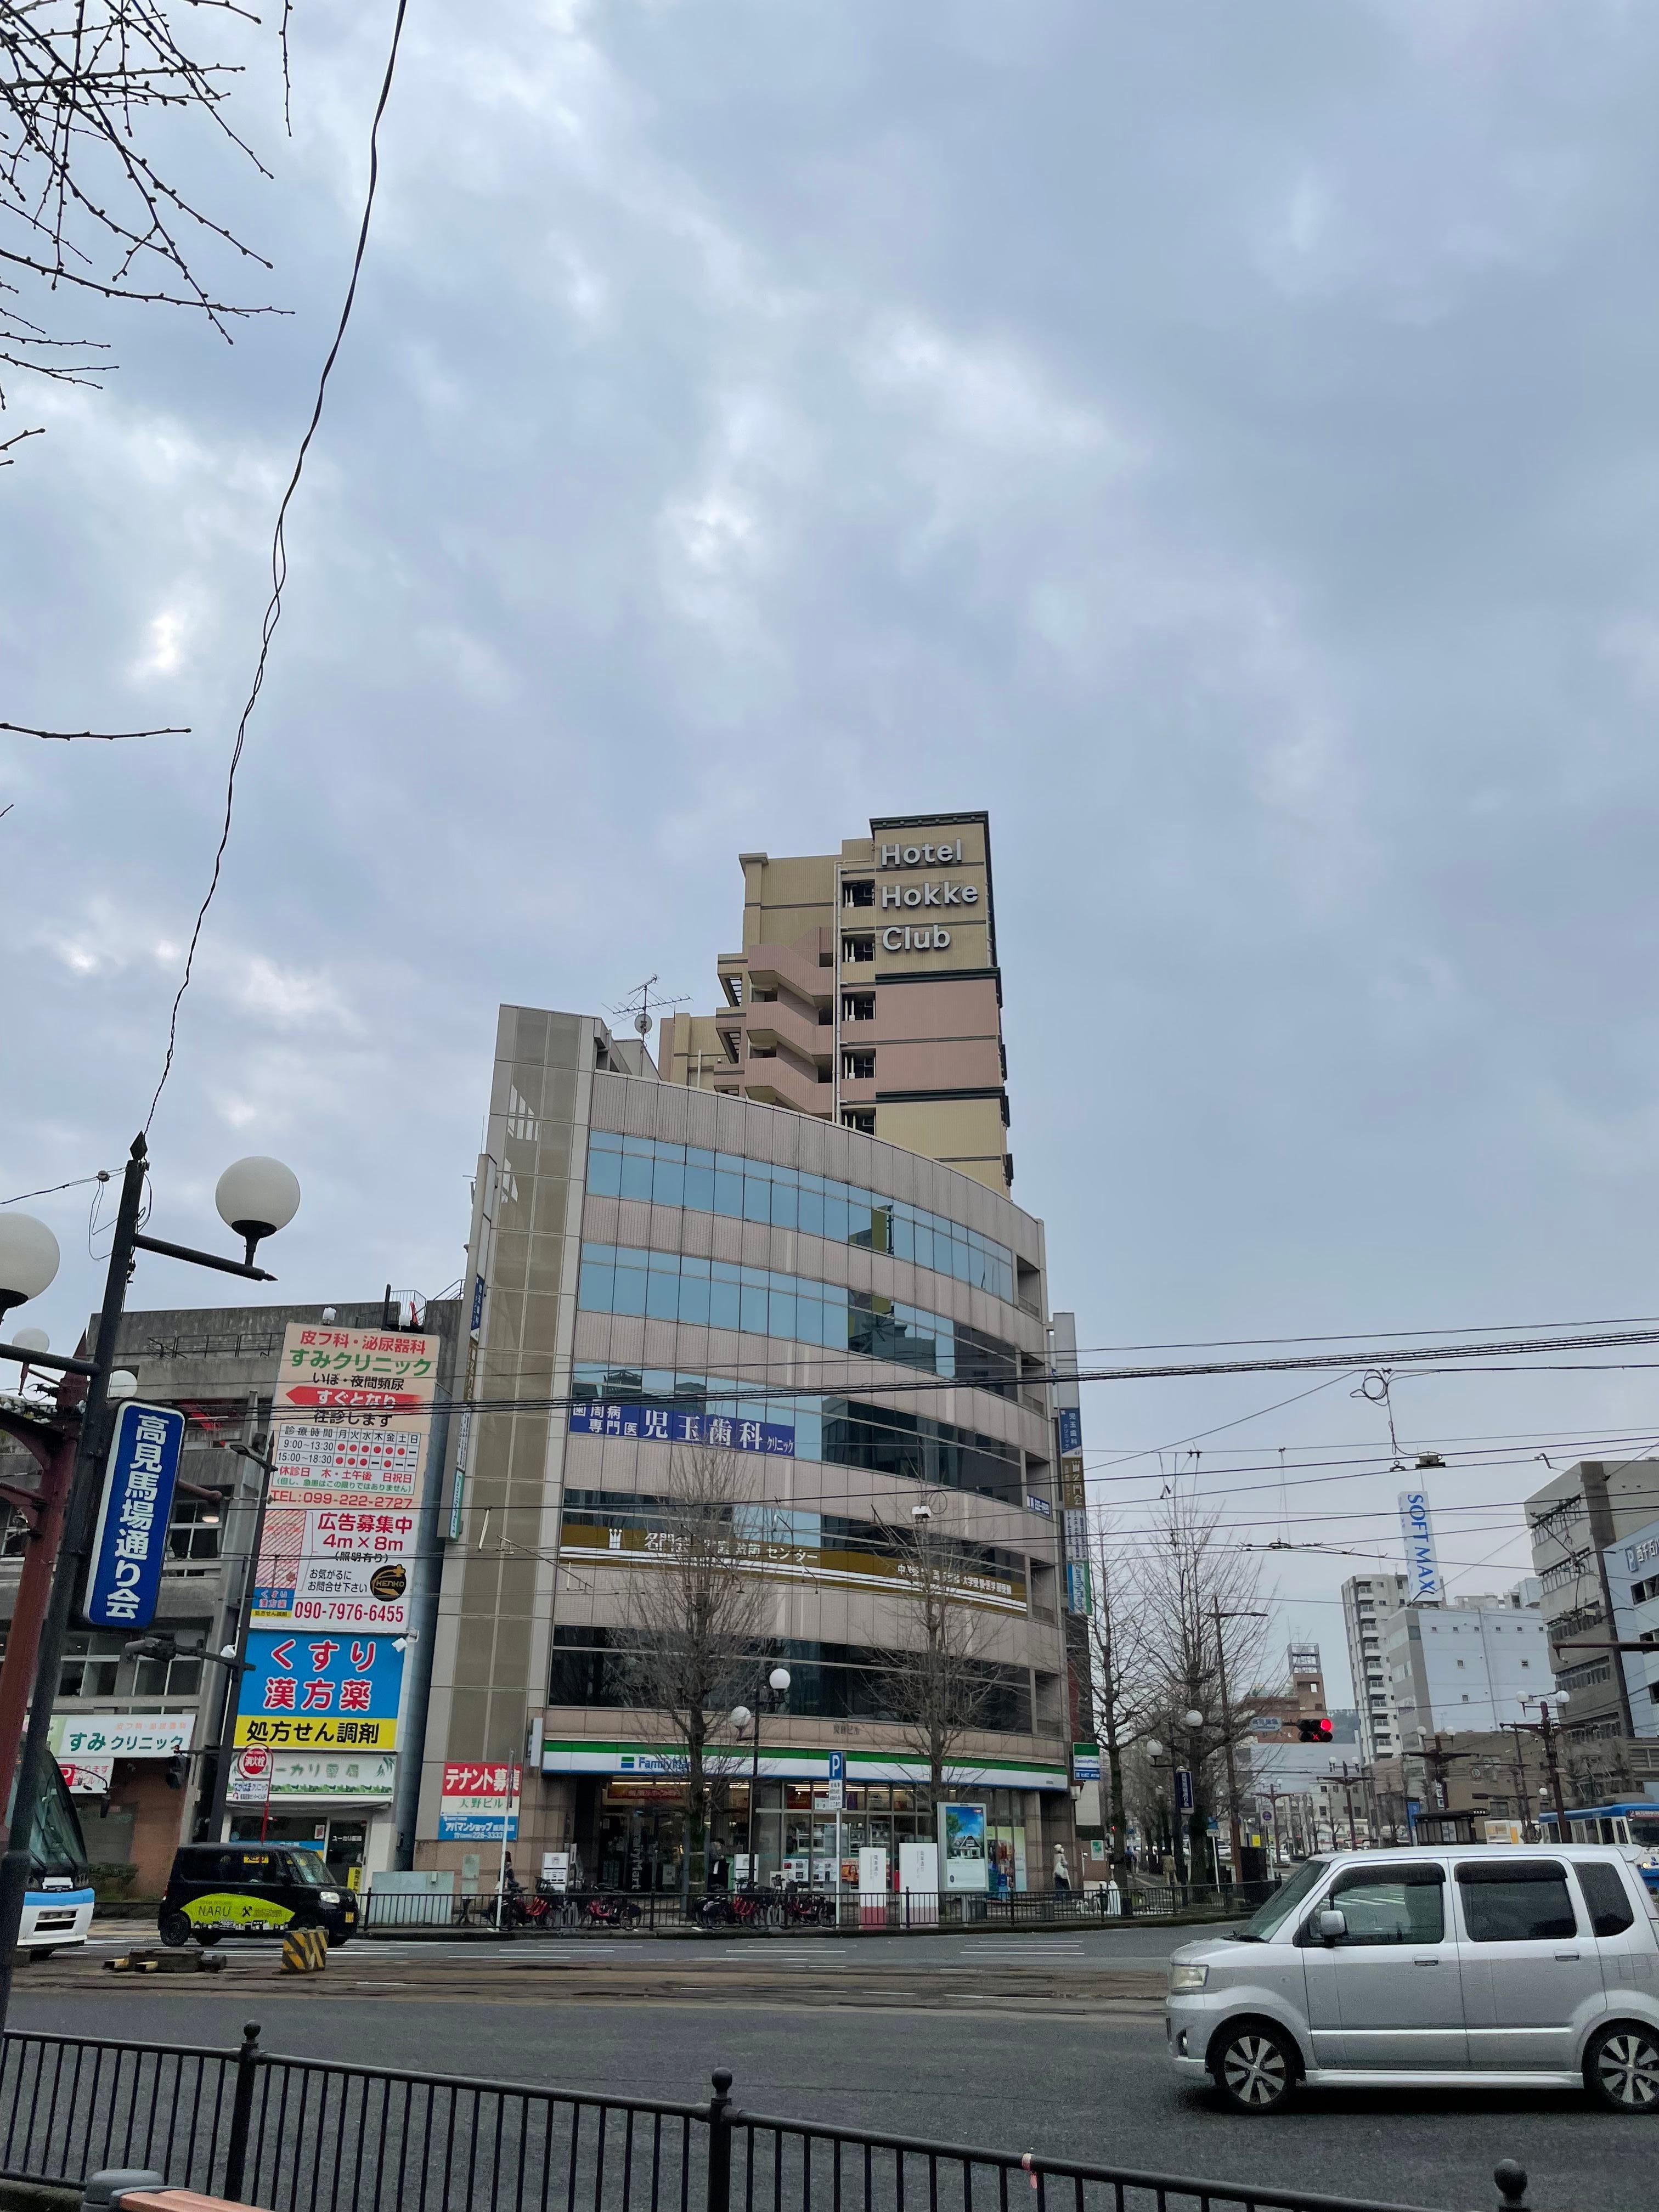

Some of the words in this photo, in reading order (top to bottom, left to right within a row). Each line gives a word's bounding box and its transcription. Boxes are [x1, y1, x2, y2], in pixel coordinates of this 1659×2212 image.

[882, 838, 962, 866] Hotel
[882, 881, 978, 909] Hokke
[882, 925, 951, 951] Club
[300, 1330, 426, 1355] 皮フ科・泌尿器科
[290, 1349, 431, 1376] すみクリニック
[313, 1372, 405, 1391] いぼ・夜間頻尿
[317, 1390, 396, 1409] すぐとなり
[573, 1403, 621, 1420] 歯周病
[285, 1425, 332, 1438] 診療時間
[338, 1430, 347, 1439] 月
[374, 1433, 383, 1441] 木
[386, 1434, 395, 1442] 金
[398, 1434, 407, 1443] 土
[410, 1435, 418, 1443] 日
[588, 1419, 637, 1437] 専門医
[643, 1409, 763, 1449] 児玉歯科
[767, 1436, 793, 1453] クリニック
[1069, 1413, 1077, 1445] 児玉歯科
[279, 1466, 311, 1477] 休診日
[321, 1468, 372, 1481] 木・土午後
[383, 1472, 412, 1483] 日祝日
[271, 1489, 413, 1509] TEL:099-222-2727
[106, 1414, 169, 1620] 高見馬場通り会
[318, 1512, 413, 1534] 広告募集中
[1407, 1494, 1429, 1543] SOFT
[309, 1569, 352, 1580] お気がるに
[1414, 1547, 1437, 1592] MAX
[308, 1581, 368, 1593] お問合せ下さい
[1074, 1564, 1085, 1610] FamilyMart
[295, 1601, 404, 1622] 090-7976-6455
[270, 1638, 376, 1673] くすり
[263, 1677, 372, 1712] 漢方薬
[70, 1732, 184, 1752] すみクリニック
[247, 1720, 379, 1744] 処方せん調剤
[832, 1754, 840, 1777] P
[445, 1768, 520, 1791] テナント募集
[198, 1906, 231, 1917] NARU
